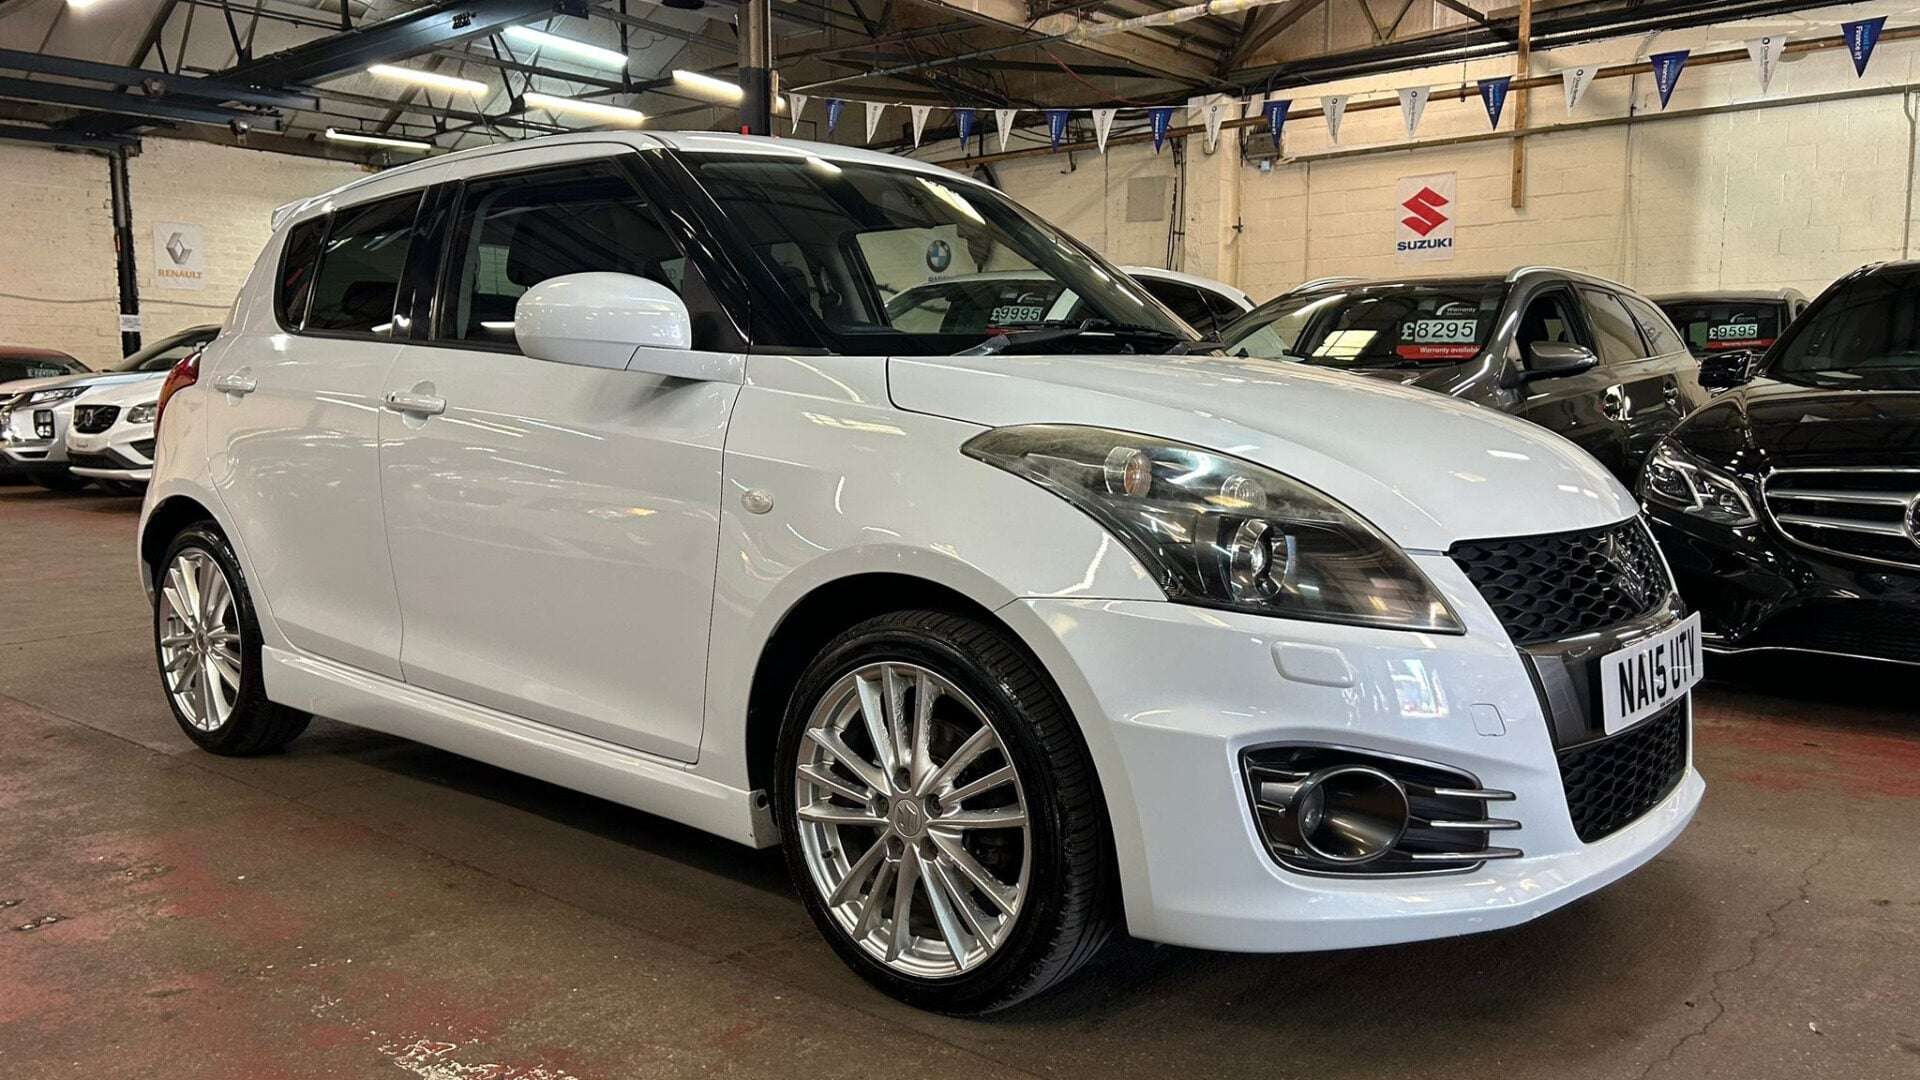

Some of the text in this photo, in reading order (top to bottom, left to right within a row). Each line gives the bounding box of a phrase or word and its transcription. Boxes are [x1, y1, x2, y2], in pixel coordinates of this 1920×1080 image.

[1397, 237, 1452, 251] SUZUKI
[158, 269, 202, 279] RENAULT
[990, 306, 1041, 321] £9995
[1400, 321, 1474, 340] £8295
[1708, 325, 1756, 339] £9595
[1618, 644, 1667, 718] NA15
